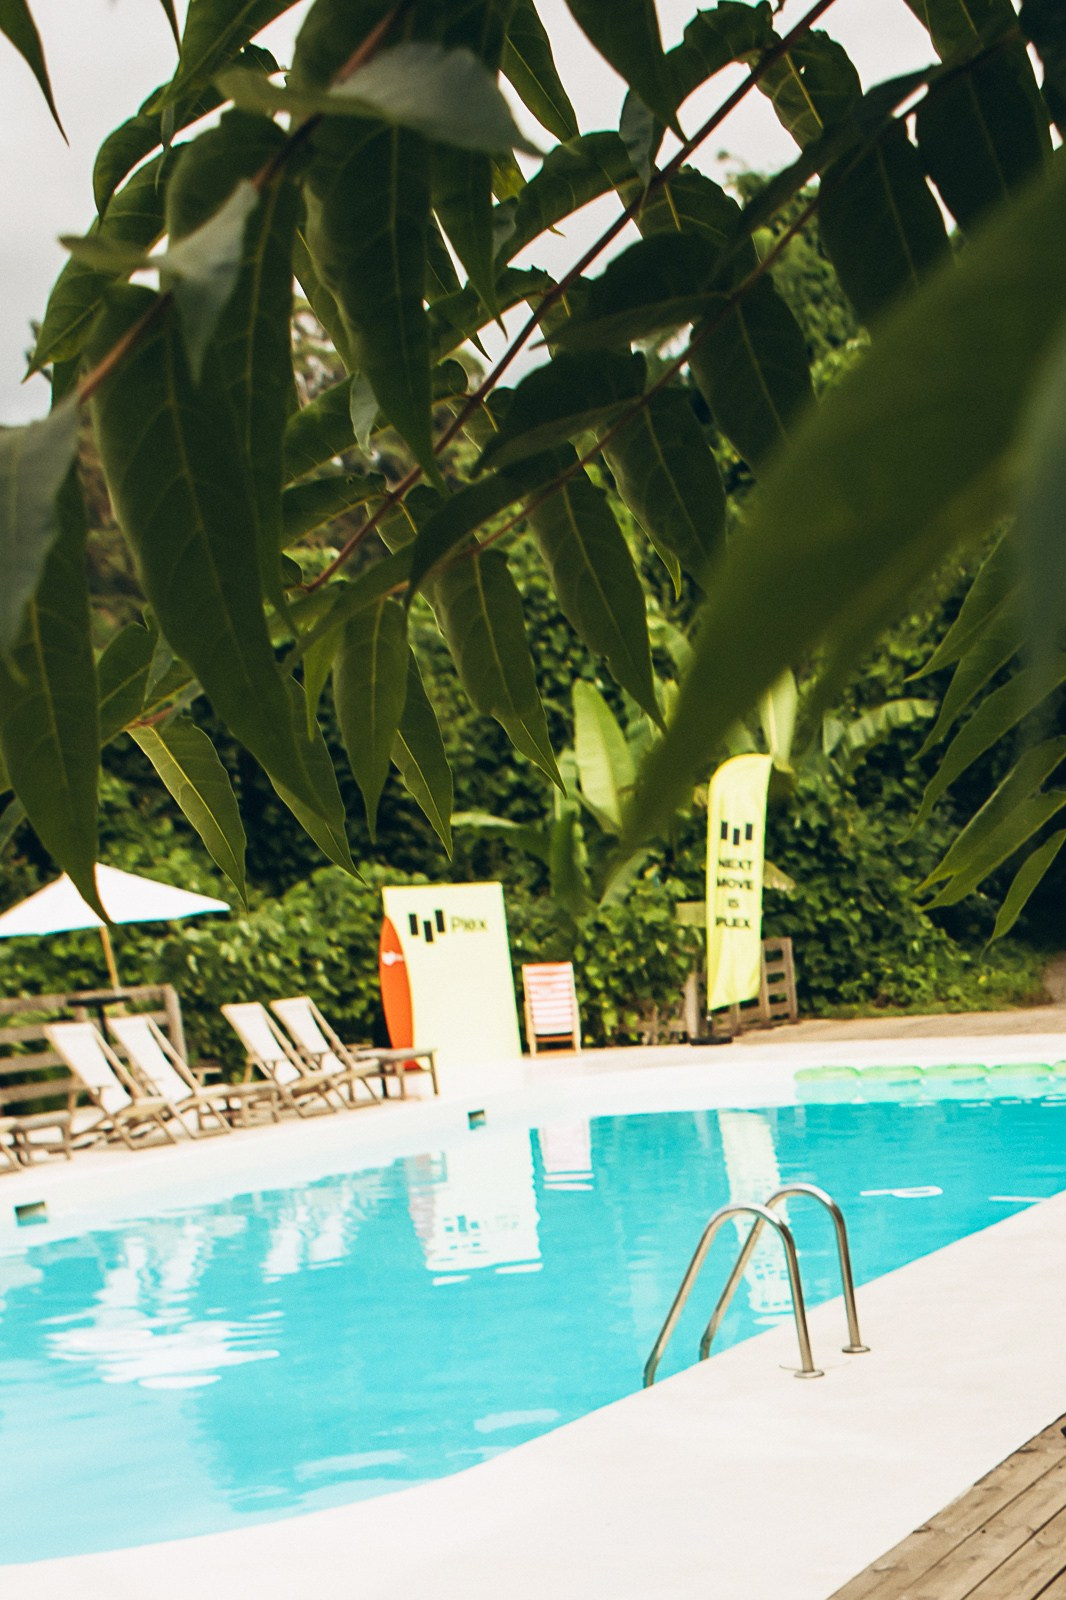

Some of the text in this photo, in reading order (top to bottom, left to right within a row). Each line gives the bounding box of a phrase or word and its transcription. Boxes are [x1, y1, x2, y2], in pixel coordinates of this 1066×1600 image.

[718, 858, 752, 871] NEXT
[716, 877, 753, 891] MOVE
[715, 916, 751, 930] PLEX
